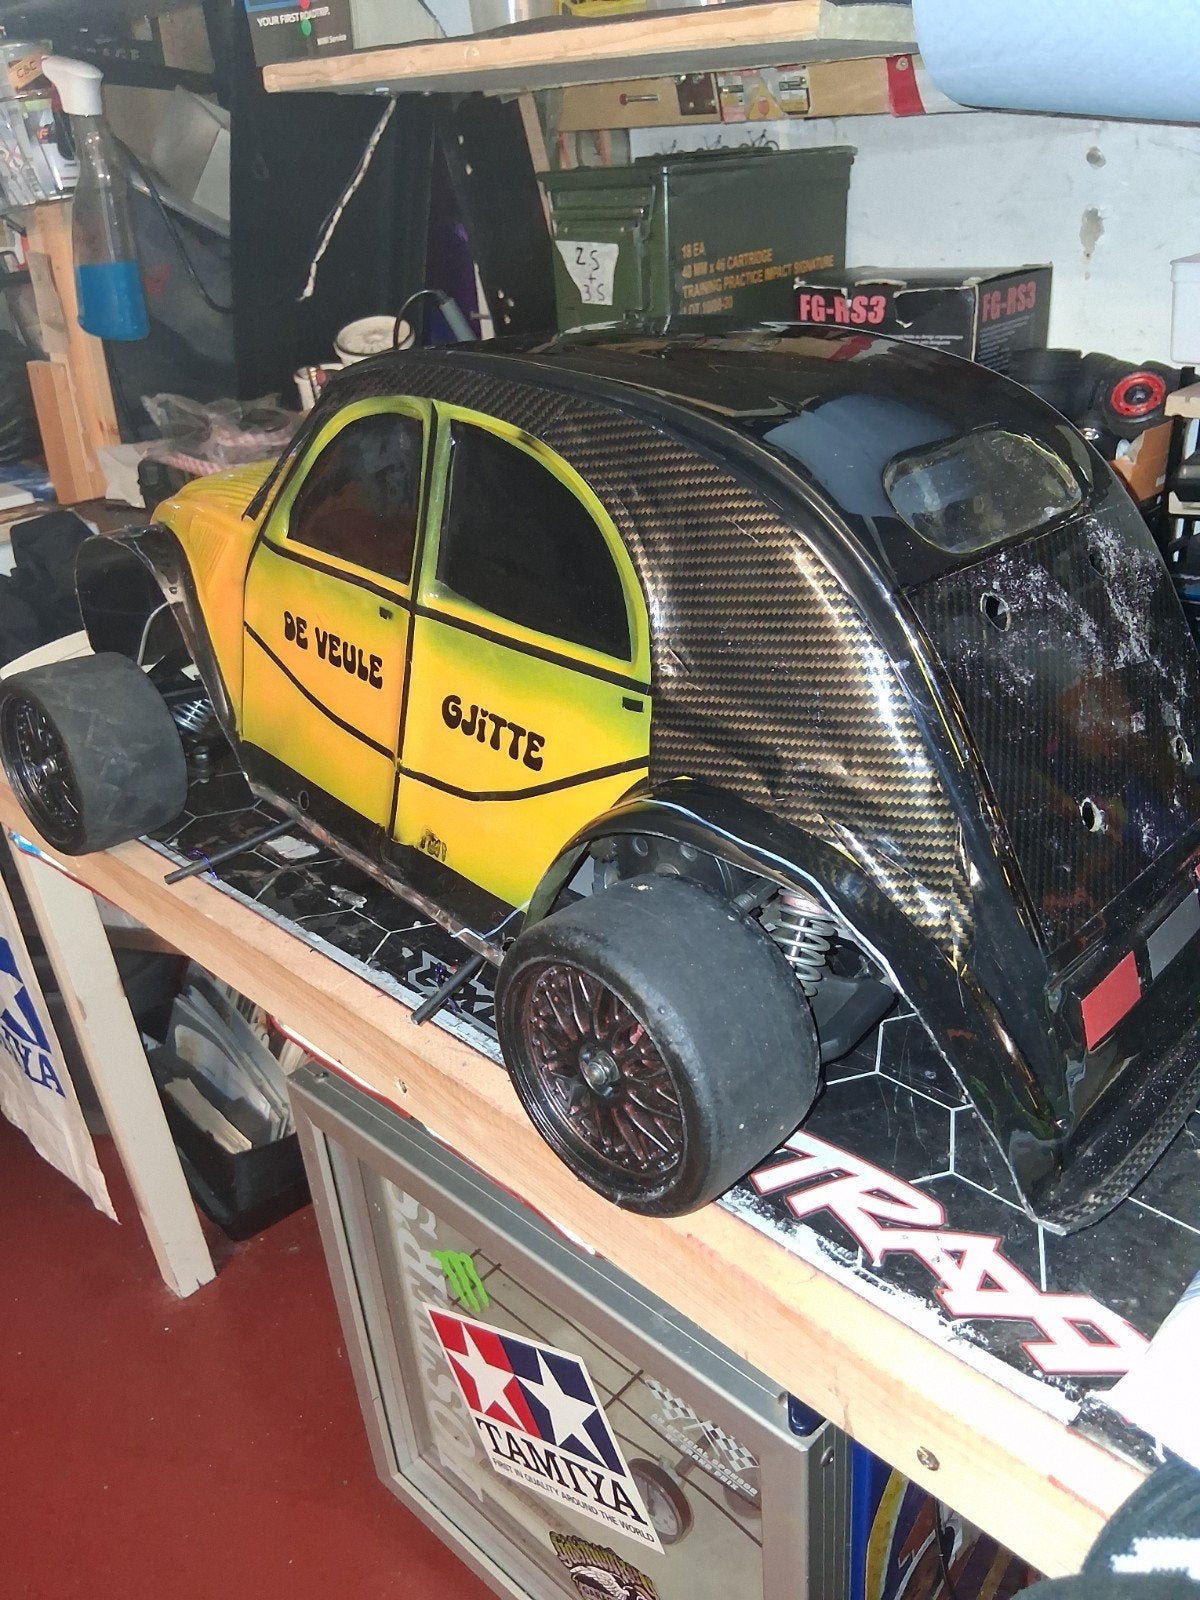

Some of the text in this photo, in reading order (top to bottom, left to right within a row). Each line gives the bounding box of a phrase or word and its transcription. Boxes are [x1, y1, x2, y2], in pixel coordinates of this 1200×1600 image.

[257, 16, 280, 28] YOUR
[280, 12, 300, 25] FIRST
[723, 269, 764, 290] PRACTICE
[800, 295, 887, 324] FG-RS3
[982, 281, 1036, 324] FG-RS3
[283, 610, 383, 690] DE VEULE
[475, 1416, 649, 1527] TAMIYA
[711, 1458, 758, 1495] SPONSOR
[493, 1457, 656, 1543] FIRST IN QUALITY AROUND THE WORLD
